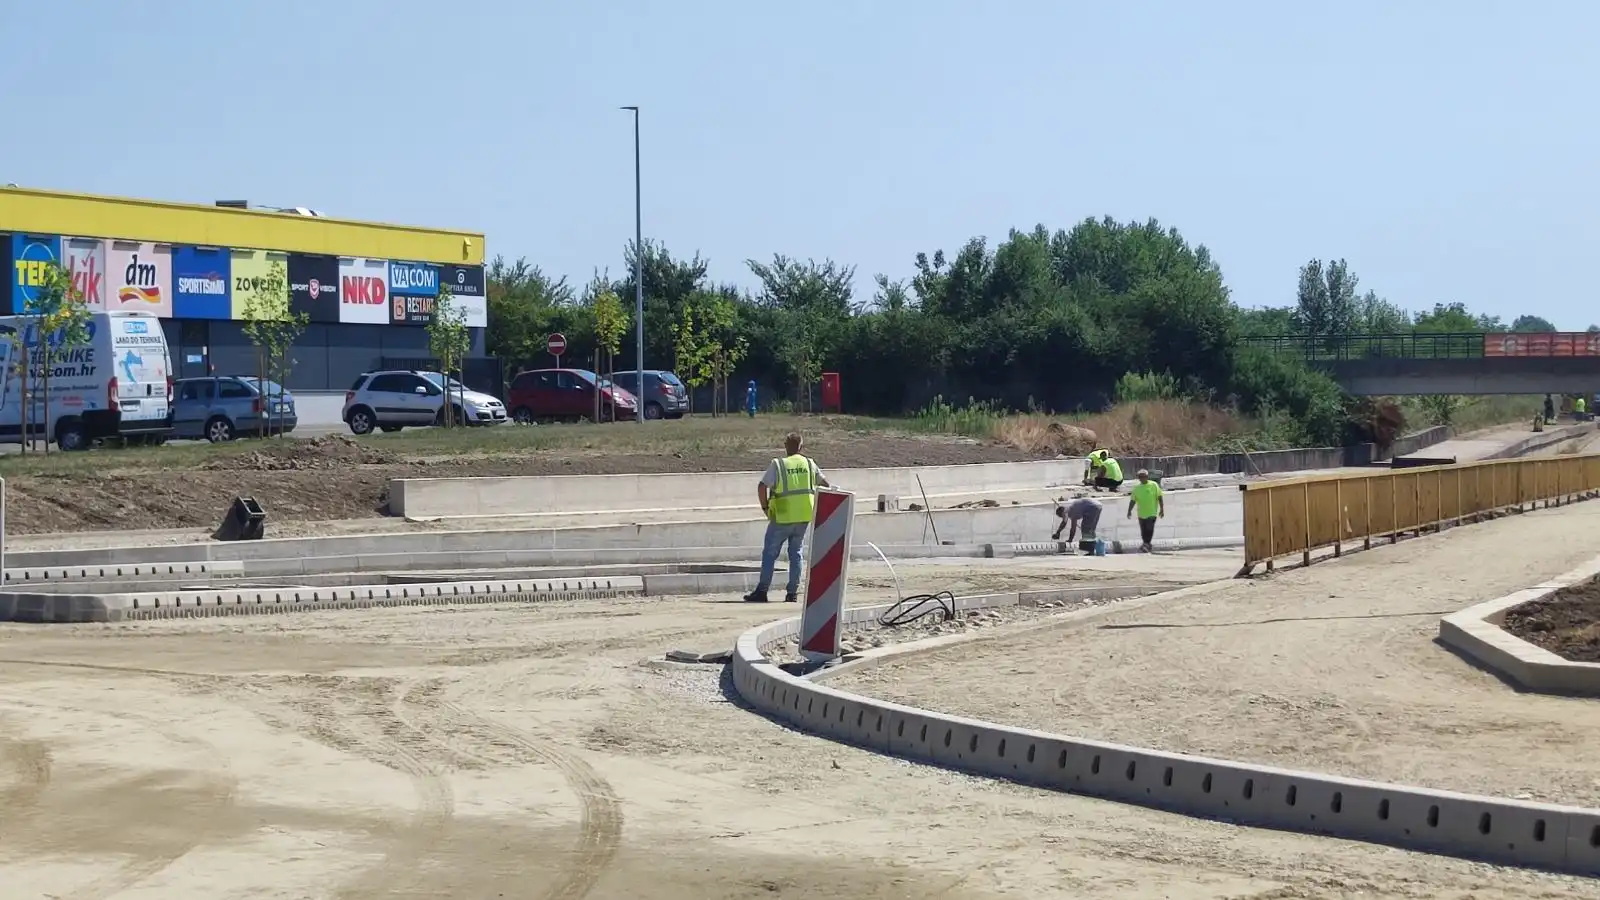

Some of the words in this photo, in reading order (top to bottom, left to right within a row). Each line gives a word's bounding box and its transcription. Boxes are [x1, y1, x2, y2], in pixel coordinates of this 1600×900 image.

[126, 254, 156, 286] dm
[391, 265, 434, 288] VACOM
[291, 283, 309, 291] SPORT
[343, 275, 386, 305] NKD
[407, 297, 434, 313] RESTART
